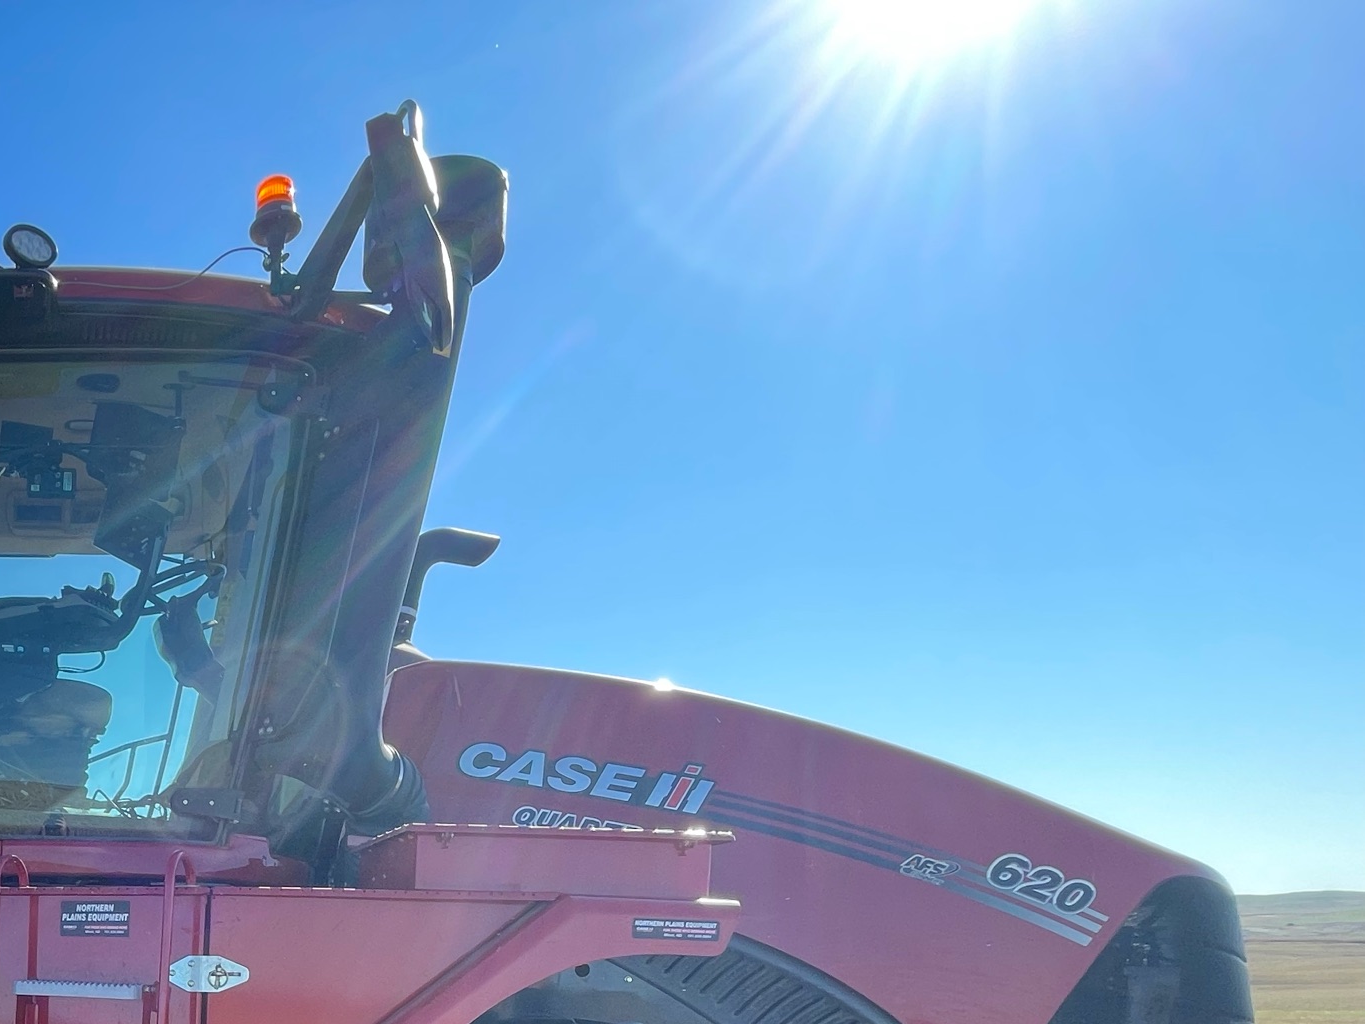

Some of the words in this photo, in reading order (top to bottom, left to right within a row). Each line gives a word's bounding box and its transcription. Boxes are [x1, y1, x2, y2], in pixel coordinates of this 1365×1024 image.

[458, 741, 646, 802] CASE
[900, 853, 950, 875] AFS
[986, 853, 1097, 915] 620
[62, 913, 86, 921] PLAINS
[88, 913, 128, 921] EQUIPMENT
[76, 904, 114, 912] NORTHERN
